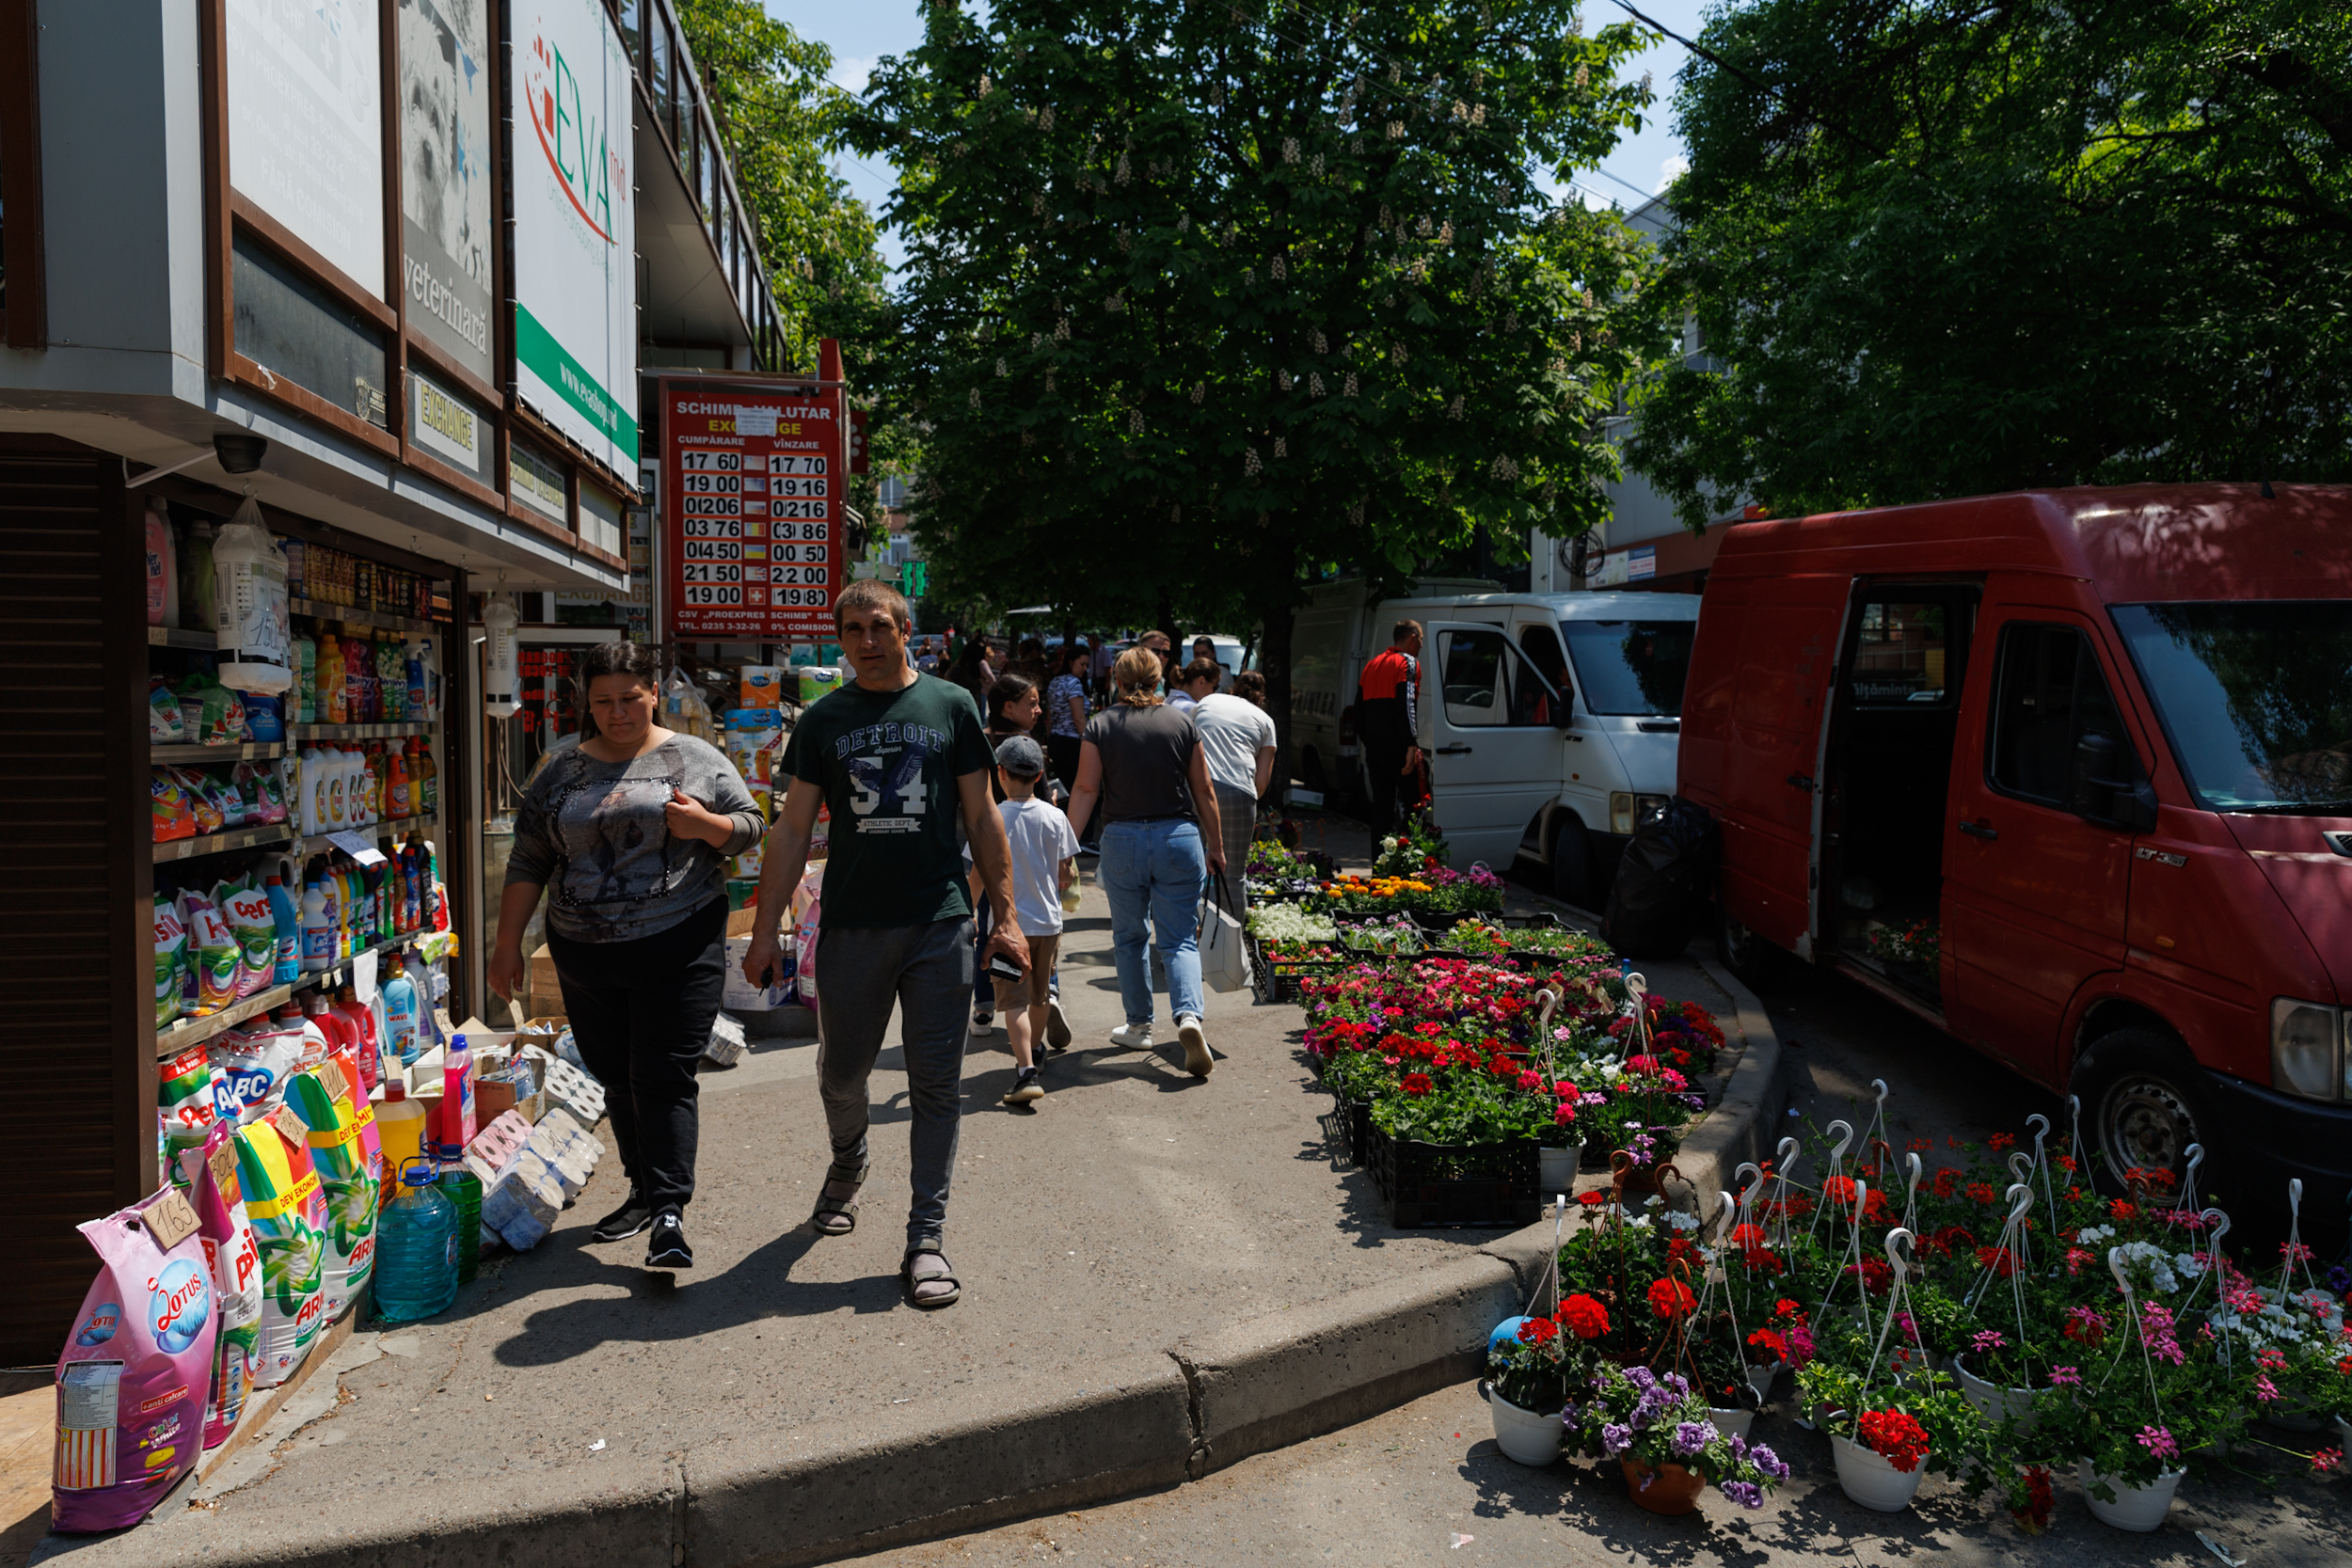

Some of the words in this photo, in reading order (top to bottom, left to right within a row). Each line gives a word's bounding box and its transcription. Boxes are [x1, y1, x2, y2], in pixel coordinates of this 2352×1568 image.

[551, 40, 614, 248] EVA
[261, 155, 295, 206] FĂRĂ
[296, 187, 352, 251] COMISION
[403, 253, 487, 355] veterinară
[421, 384, 473, 452] EXCHANGE
[677, 435, 745, 446] CUMPĂRARE
[773, 437, 819, 449] VÎNZARE
[535, 457, 565, 511] VALUTAR
[678, 622, 699, 630] TEL.
[701, 622, 724, 630] 0235
[771, 623, 786, 631] 0%
[787, 623, 835, 631] COMISION
[835, 722, 946, 761] DETROIT
[850, 756, 928, 816] 54
[2135, 847, 2158, 861] LT
[2156, 851, 2189, 867] 35
[388, 1014, 408, 1022] WAVE
[279, 1192, 294, 1209] DEV
[157, 1193, 193, 1239] 165
[157, 1273, 202, 1333] LOTUS
[237, 1304, 257, 1320] COLOR
[296, 1319, 316, 1337] AQUA
[143, 1398, 164, 1411] +anti
[164, 1388, 188, 1403] calcare
[149, 1412, 179, 1439] Color
[151, 1422, 182, 1449] White
